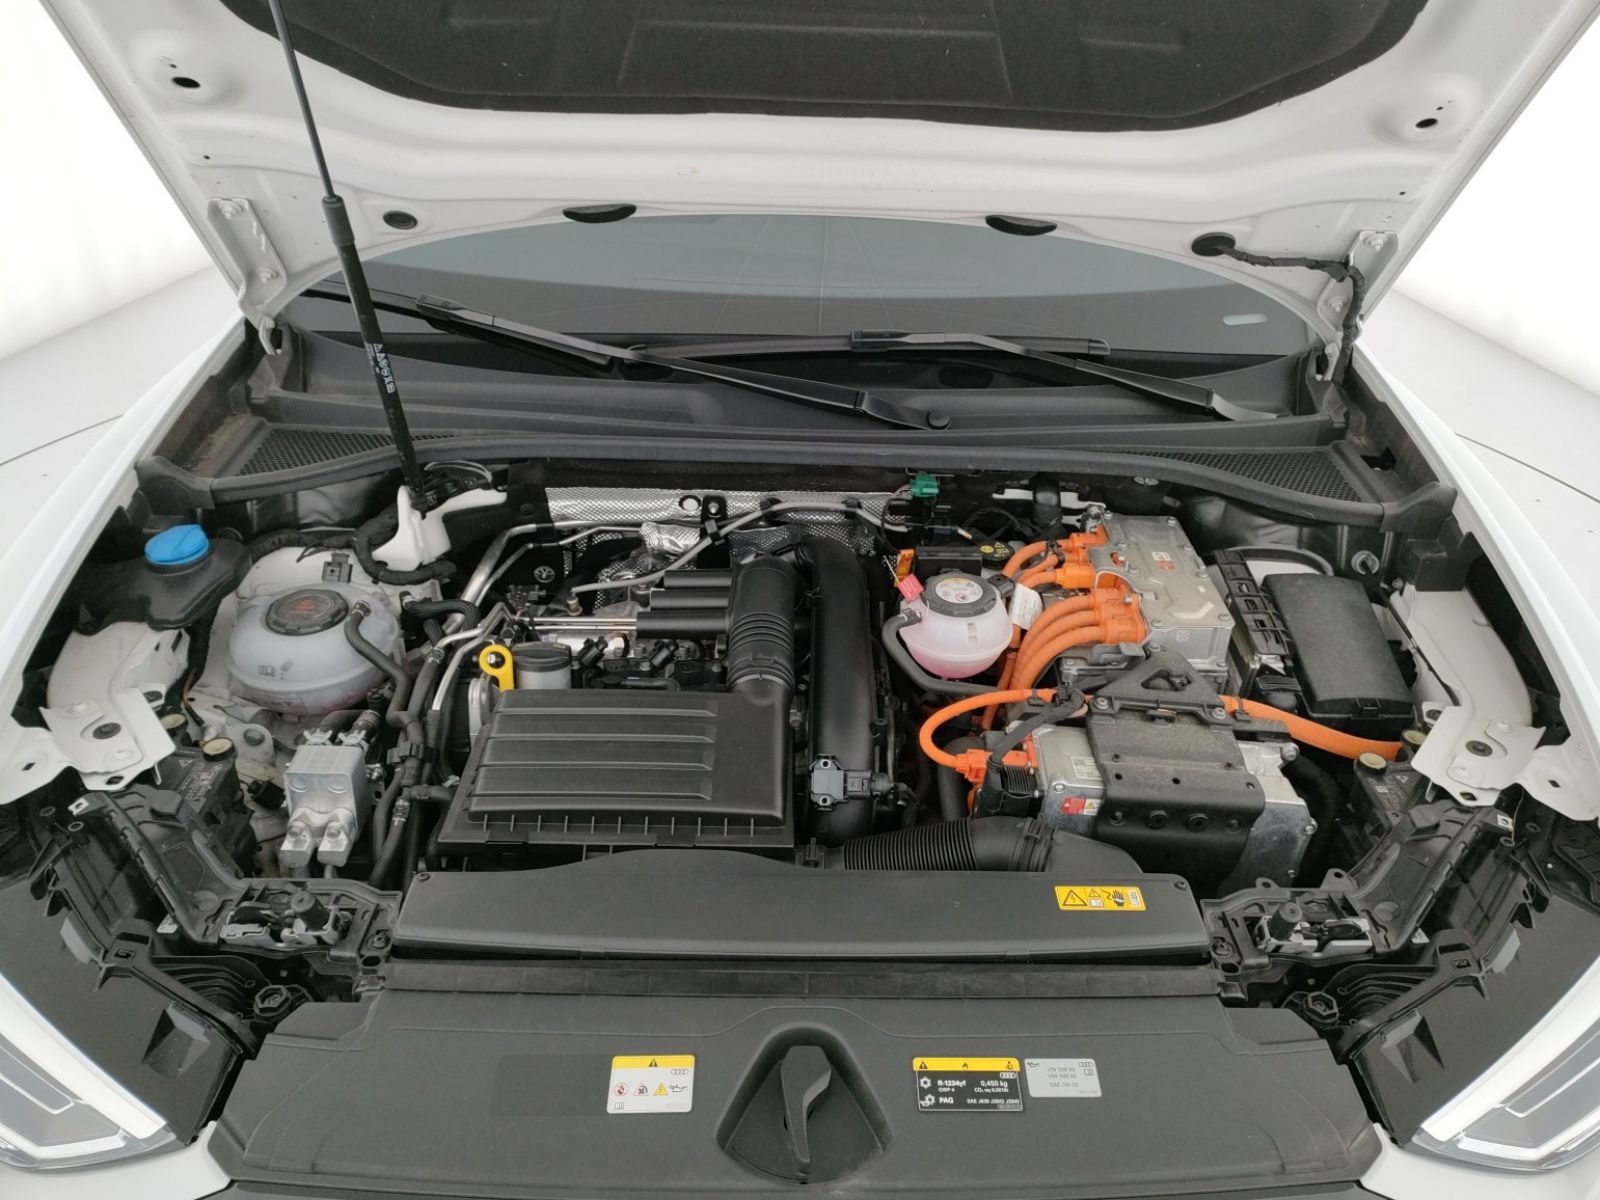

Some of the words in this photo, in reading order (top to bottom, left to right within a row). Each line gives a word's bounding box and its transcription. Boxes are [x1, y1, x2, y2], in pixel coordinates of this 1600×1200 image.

[937, 1080, 966, 1088] R-1234yf
[1000, 1080, 1008, 1088] kg
[939, 1096, 954, 1104] PAG
